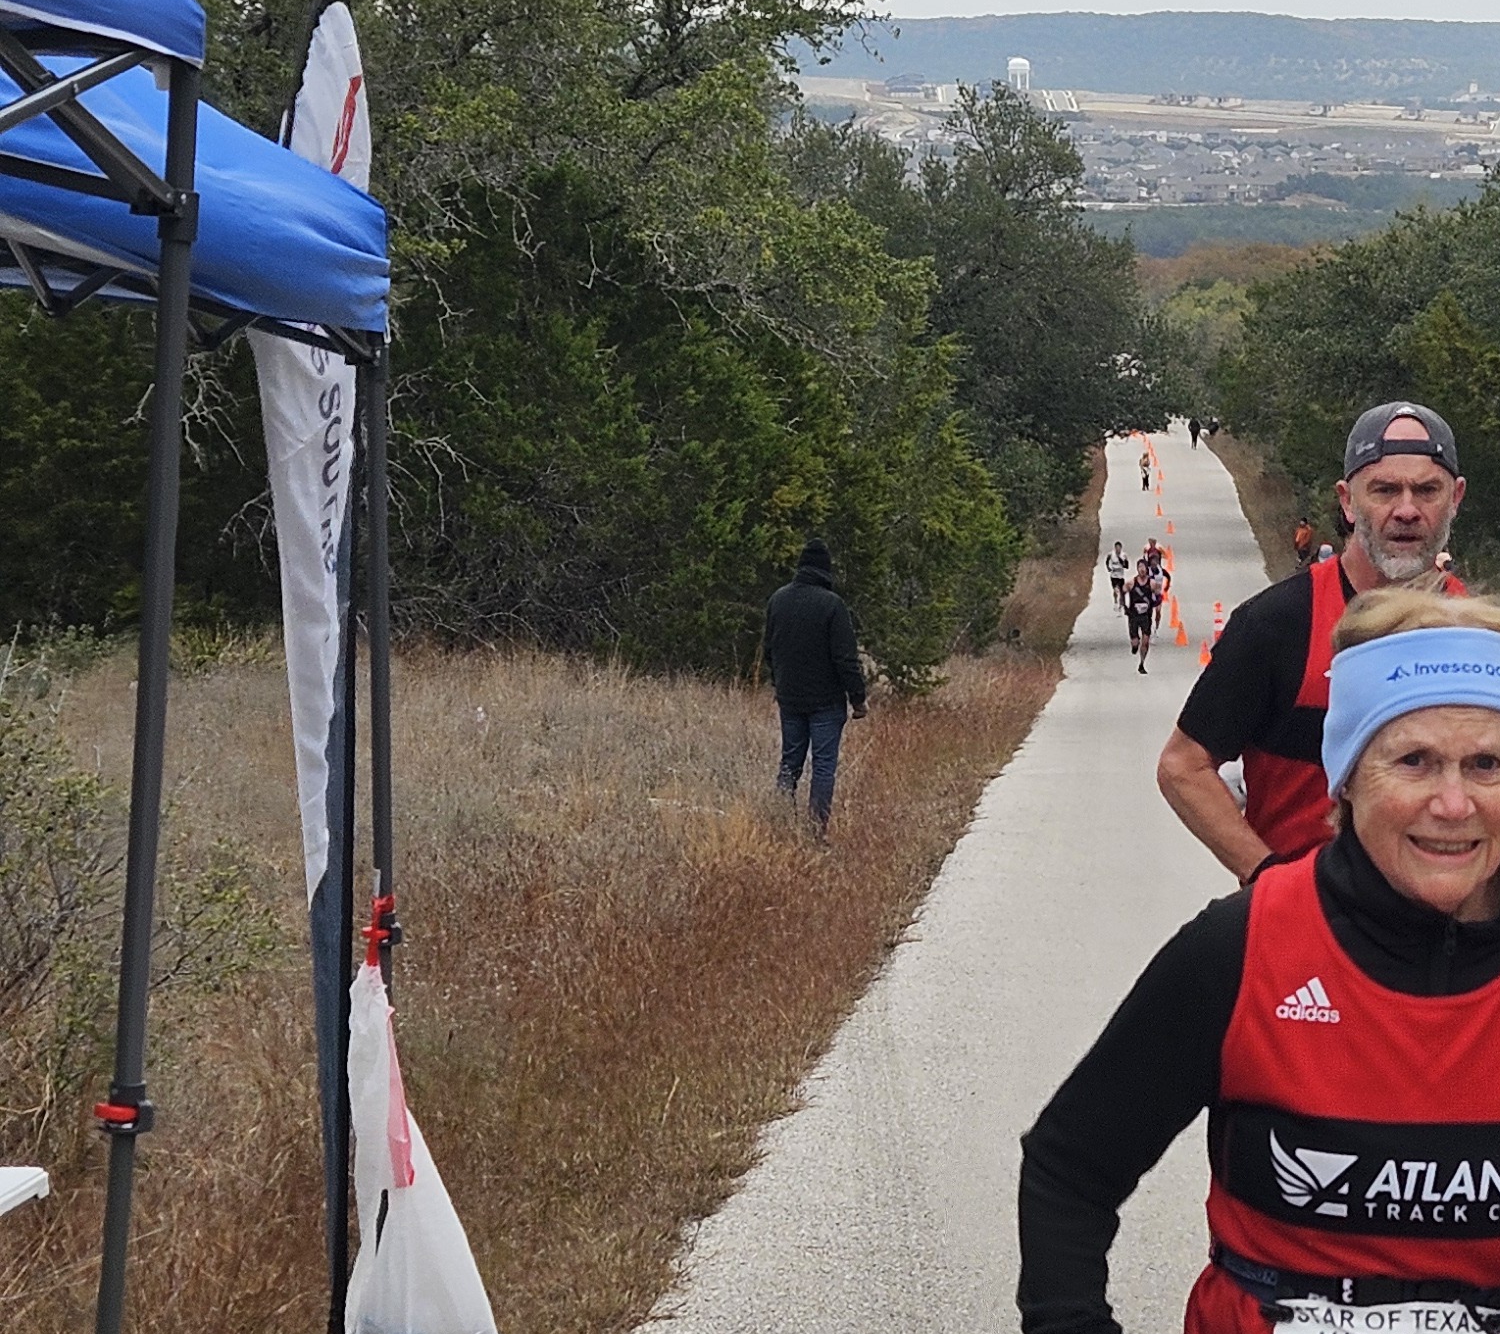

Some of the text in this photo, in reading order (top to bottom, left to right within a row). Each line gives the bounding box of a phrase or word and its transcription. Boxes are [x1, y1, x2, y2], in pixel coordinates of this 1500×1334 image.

[1414, 662, 1482, 676] Invesco
[1275, 1004, 1341, 1024] adidas
[1365, 1202, 1468, 1223] TRACK
[1295, 1305, 1355, 1329] STAR
[1365, 1310, 1402, 1331] OF
